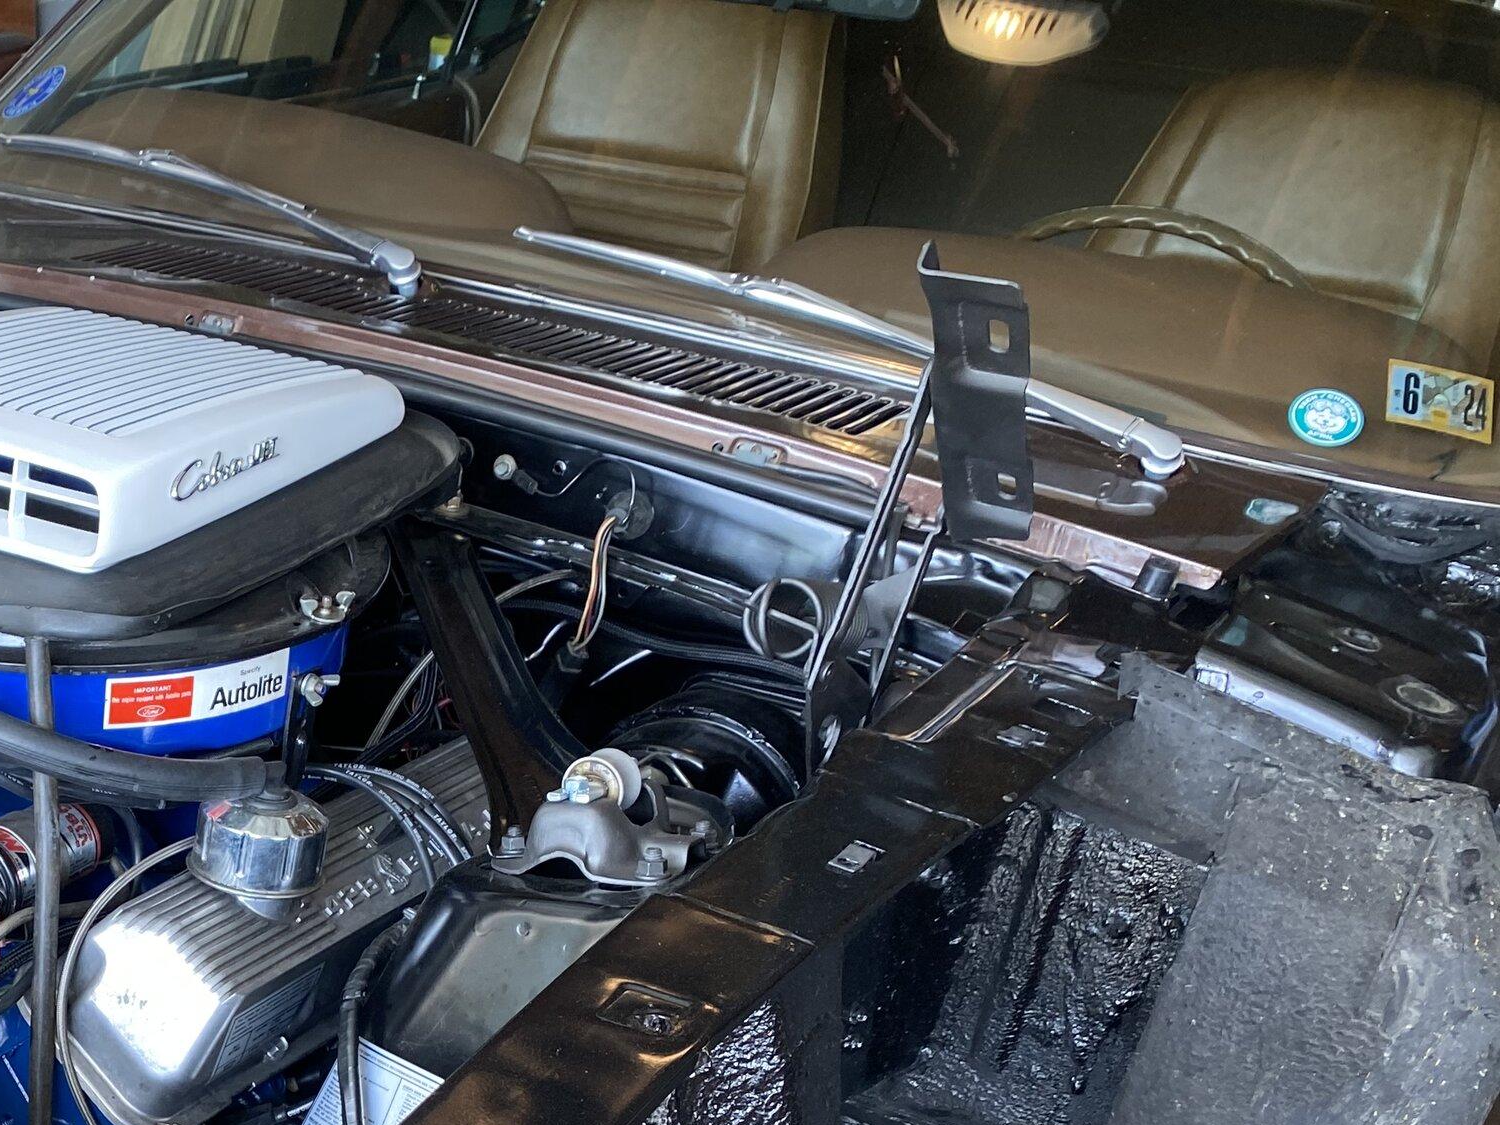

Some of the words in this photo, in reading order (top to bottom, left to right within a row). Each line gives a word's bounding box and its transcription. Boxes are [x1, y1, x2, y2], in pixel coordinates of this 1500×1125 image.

[1402, 372, 1420, 415] 6
[1463, 383, 1487, 430] 24
[240, 665, 262, 676] Specify
[133, 684, 171, 694] IMPORTANT
[210, 672, 283, 710] Autolite
[333, 762, 366, 770] TAYLOR
[434, 813, 457, 842] TAYLOR
